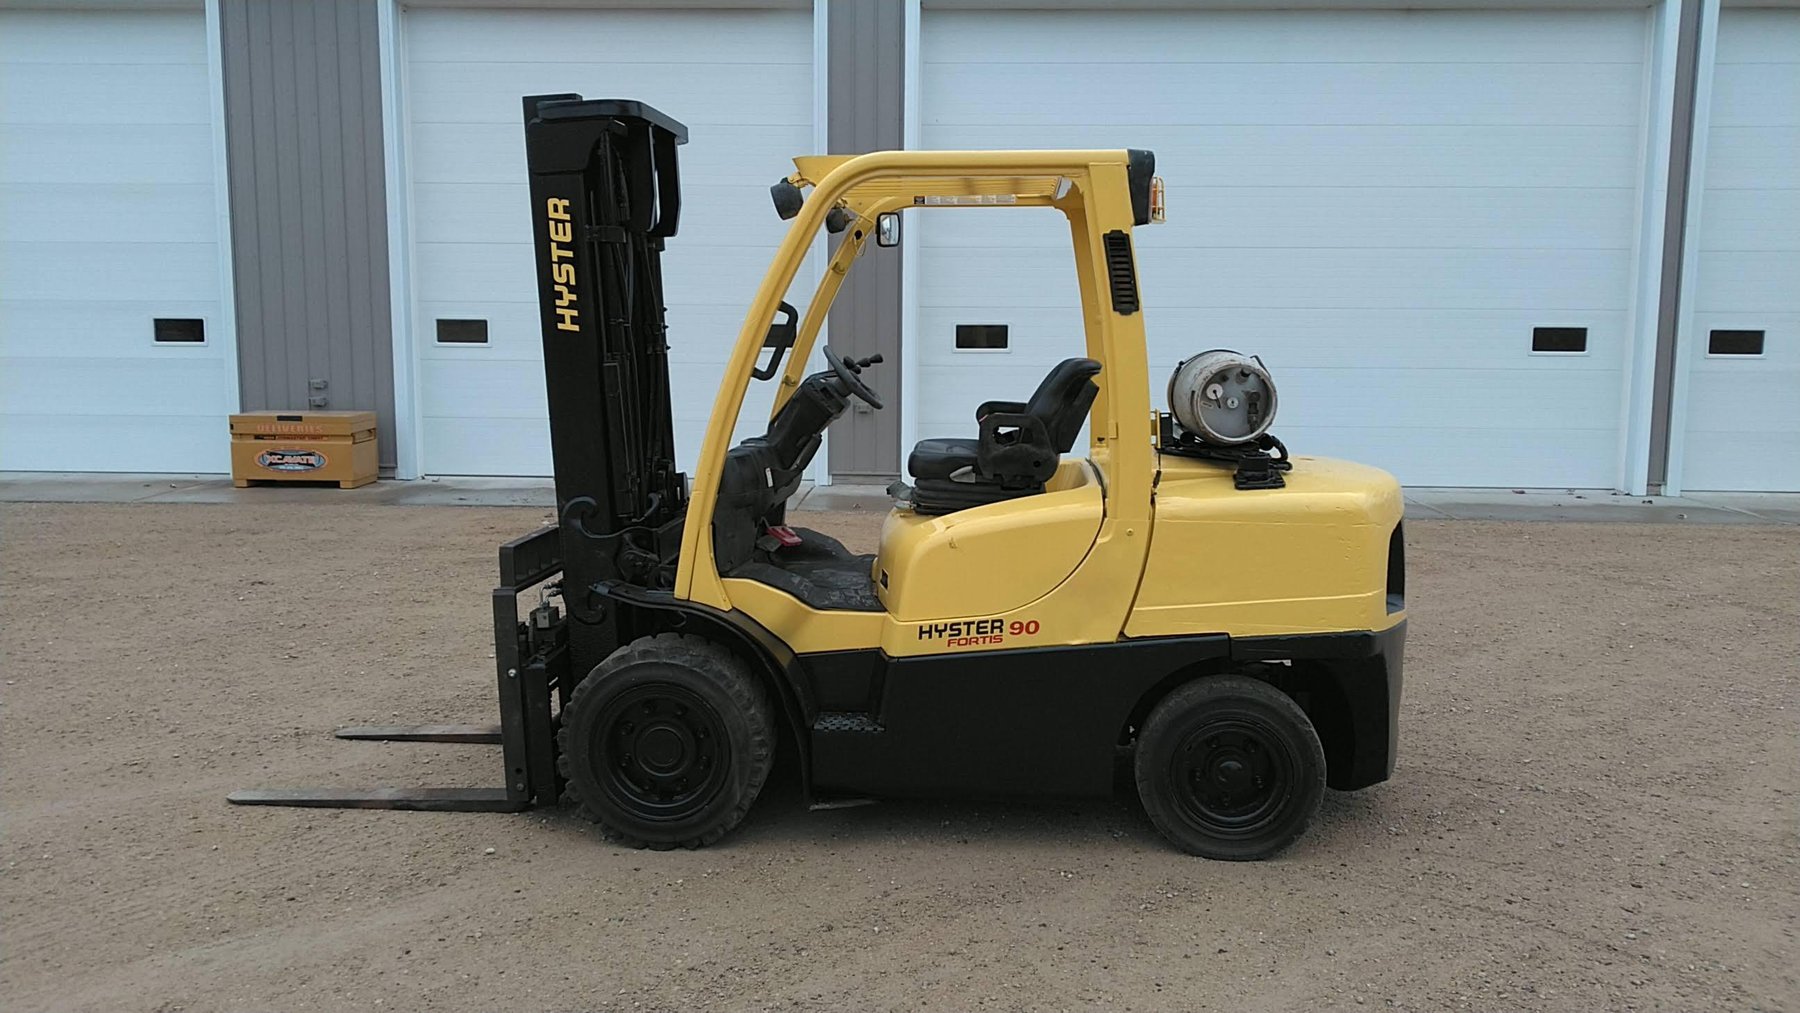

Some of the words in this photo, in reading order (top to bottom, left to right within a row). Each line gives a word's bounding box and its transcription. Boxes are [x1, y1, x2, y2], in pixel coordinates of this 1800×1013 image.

[547, 197, 580, 332] HYSTER
[256, 423, 323, 433] DELIVERIES
[918, 619, 1004, 640] HYSTER
[1009, 620, 1040, 635] 90
[947, 635, 1003, 647] FORTIS
